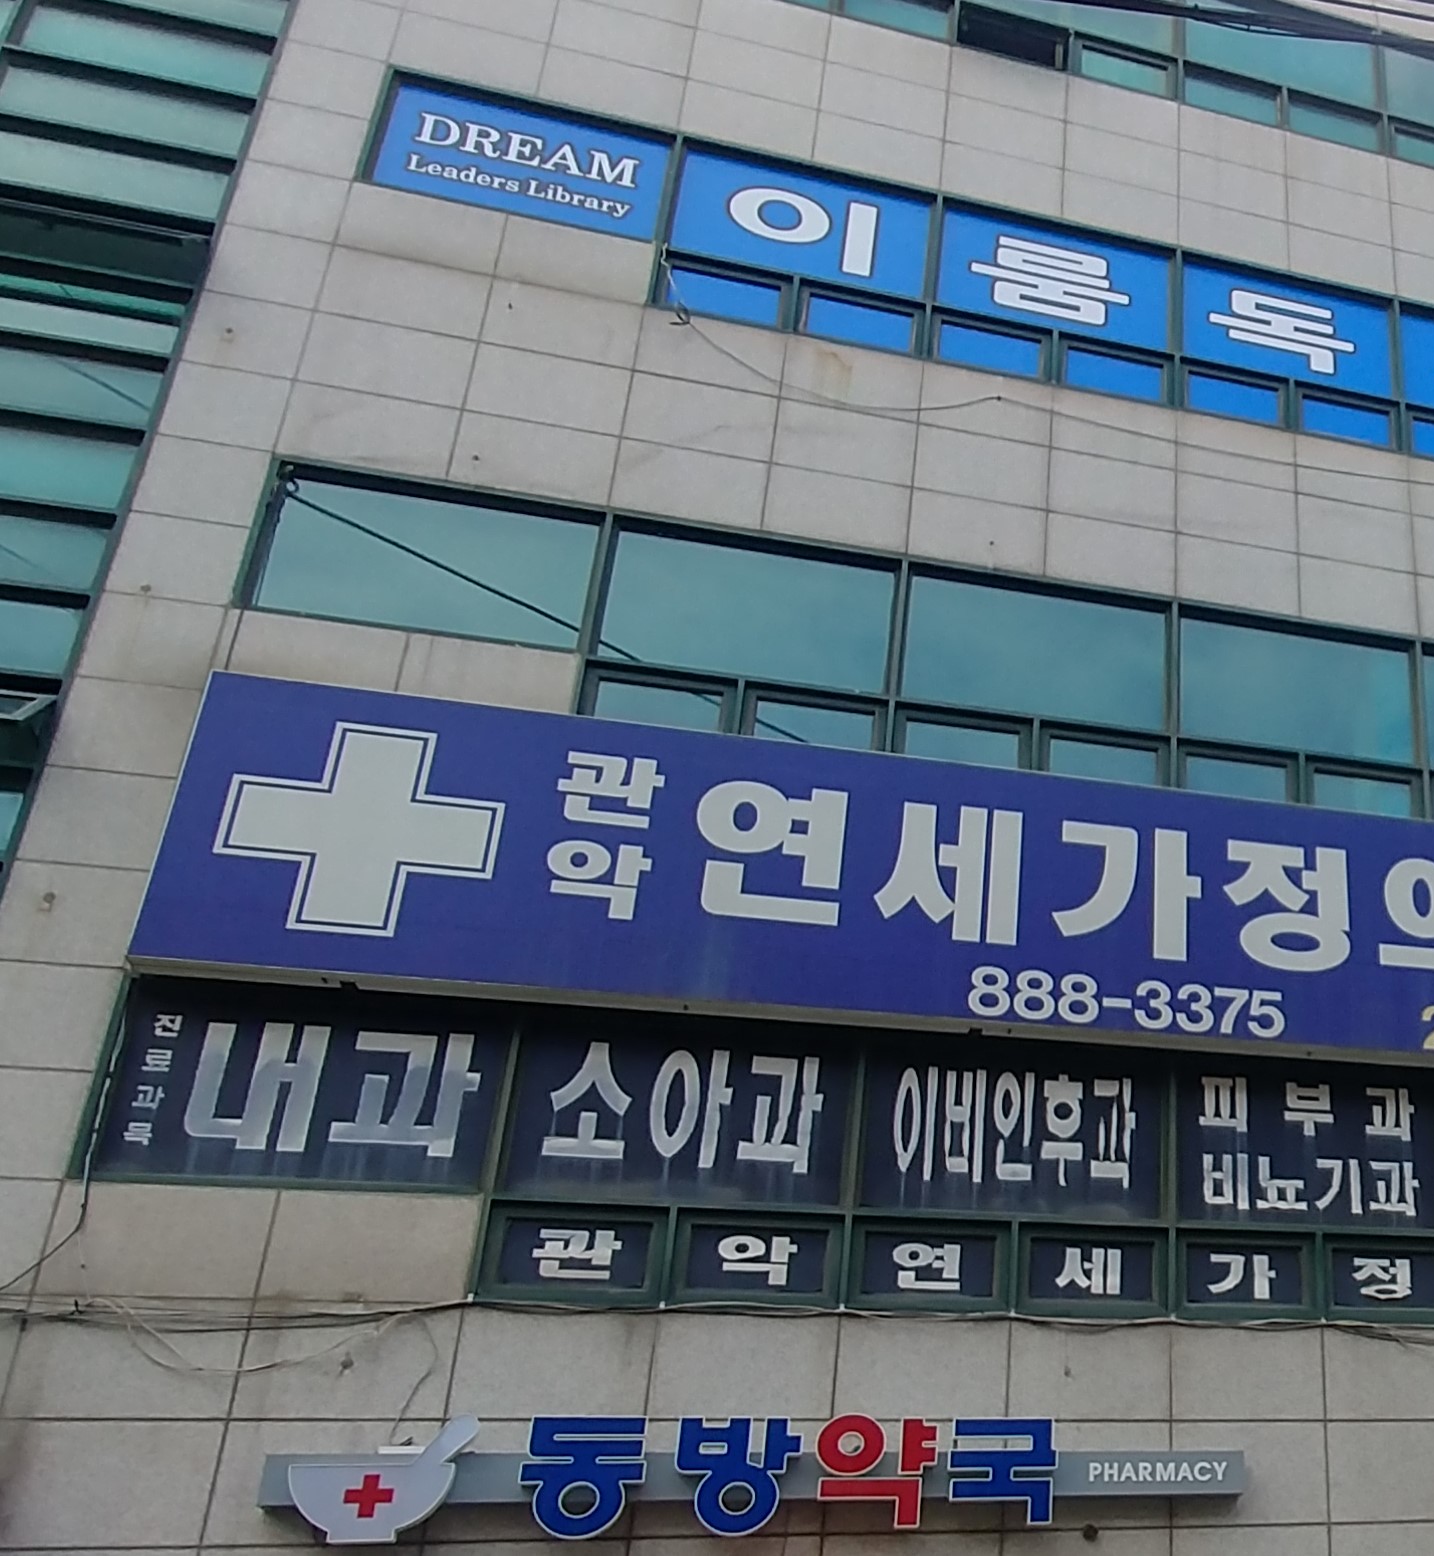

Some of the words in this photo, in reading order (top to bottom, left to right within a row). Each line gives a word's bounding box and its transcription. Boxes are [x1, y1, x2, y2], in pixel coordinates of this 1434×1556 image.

[407, 154, 520, 195] Leaders
[527, 178, 631, 218] Library
[415, 112, 639, 188] DREAM
[968, 966, 1286, 1039] 888-3375
[123, 1013, 183, 1146] 진료과목
[184, 1022, 481, 1157] 내과
[541, 1041, 823, 1174] 소아과
[893, 1065, 1136, 1189] 이비인후과
[1199, 1076, 1415, 1142] 피부과
[1202, 1152, 1419, 1217] 비뇨기과
[518, 1413, 1058, 1539] 동방약국
[1088, 1461, 1227, 1482] PHARMACY
